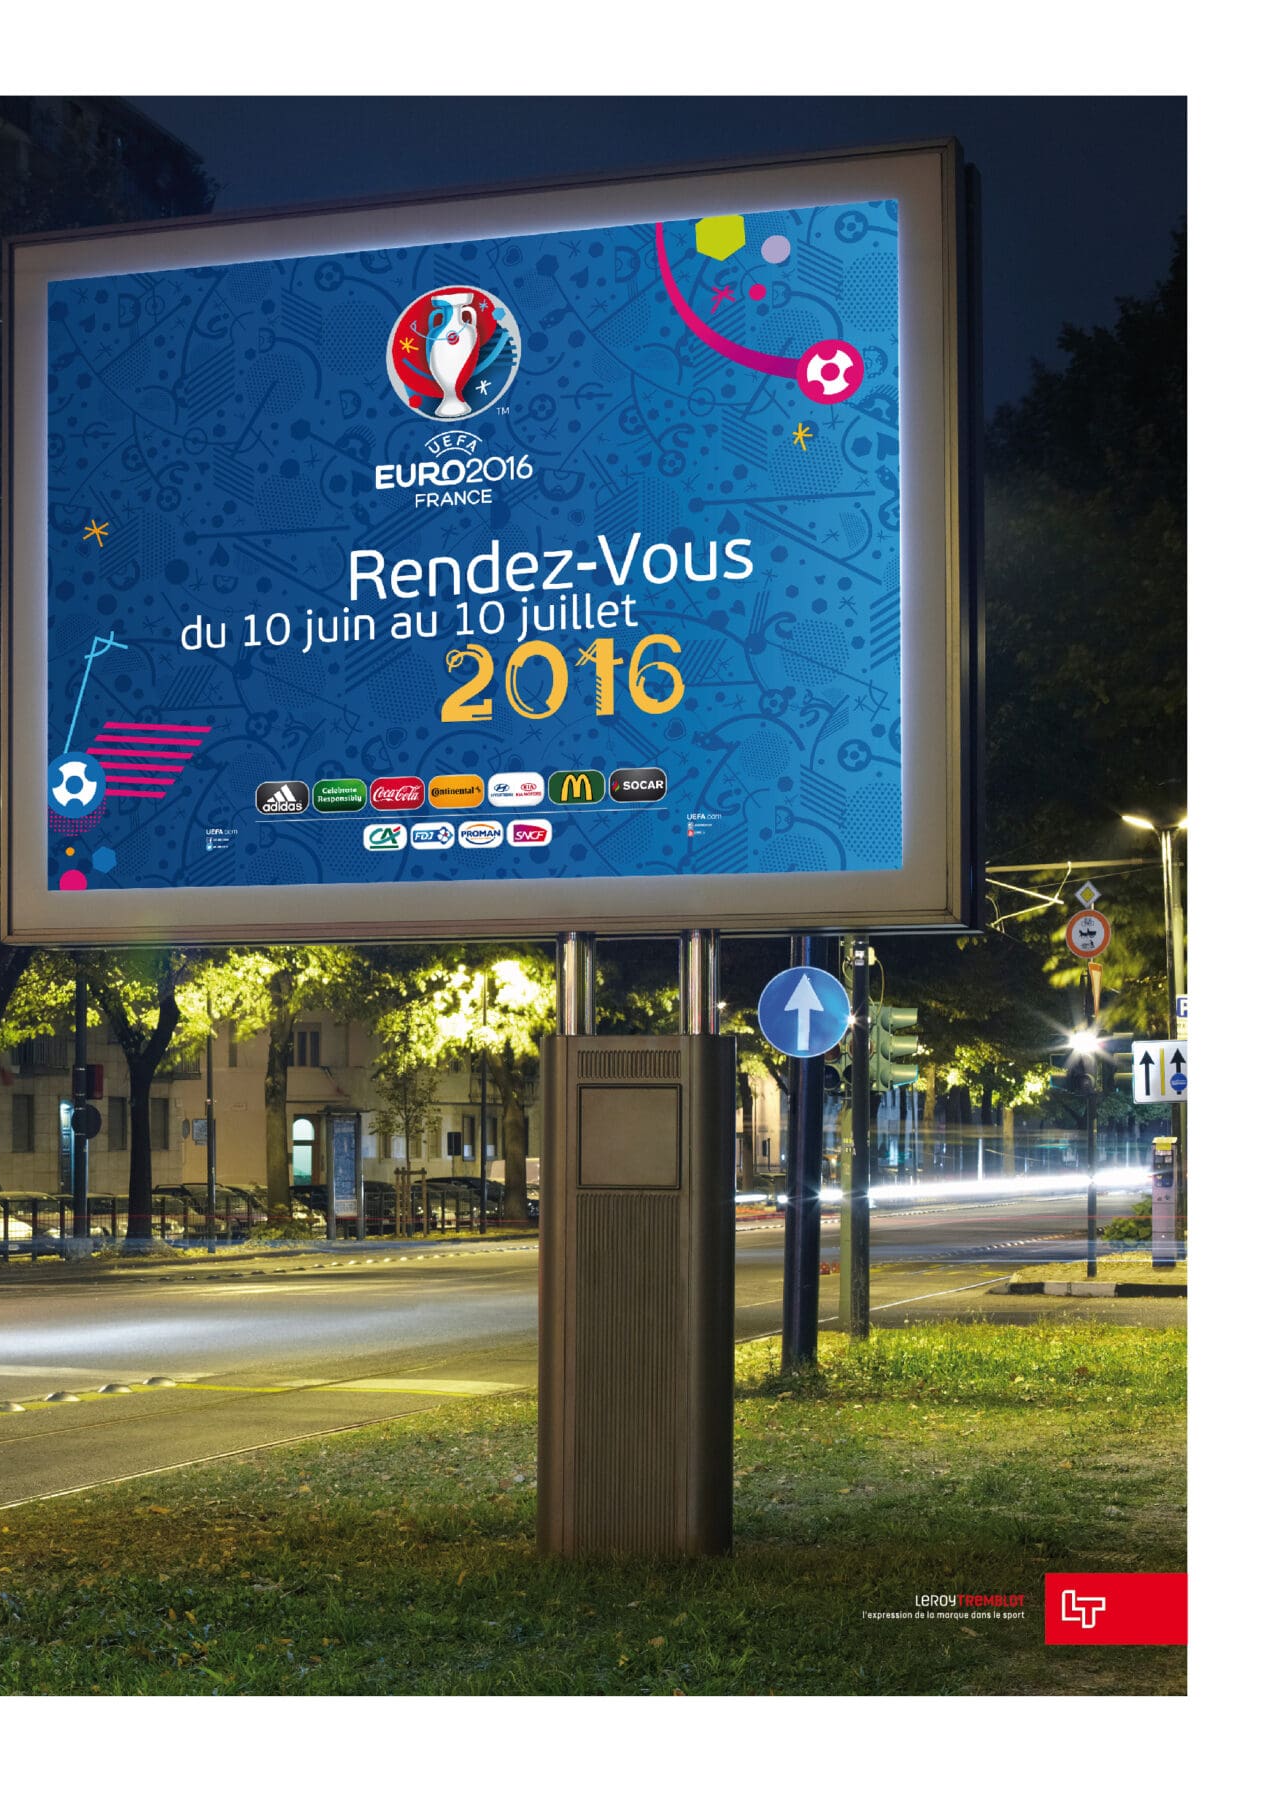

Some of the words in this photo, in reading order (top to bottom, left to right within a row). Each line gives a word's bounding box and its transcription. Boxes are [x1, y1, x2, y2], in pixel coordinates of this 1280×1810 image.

[427, 434, 477, 454] UEFA
[415, 489, 493, 508] FRANCE
[348, 532, 754, 601] Rendez-Vous
[181, 615, 226, 650] du
[243, 612, 291, 647] 10
[303, 608, 376, 653] juin
[391, 609, 437, 640] au
[456, 600, 506, 636] 10
[517, 593, 639, 643] juillet
[440, 633, 686, 722] 2016
[623, 780, 664, 790] SOCAR
[262, 801, 303, 812] adidas
[318, 795, 362, 803] Responsibly
[461, 829, 500, 838] PROMAN
[514, 831, 545, 841] SNCF
